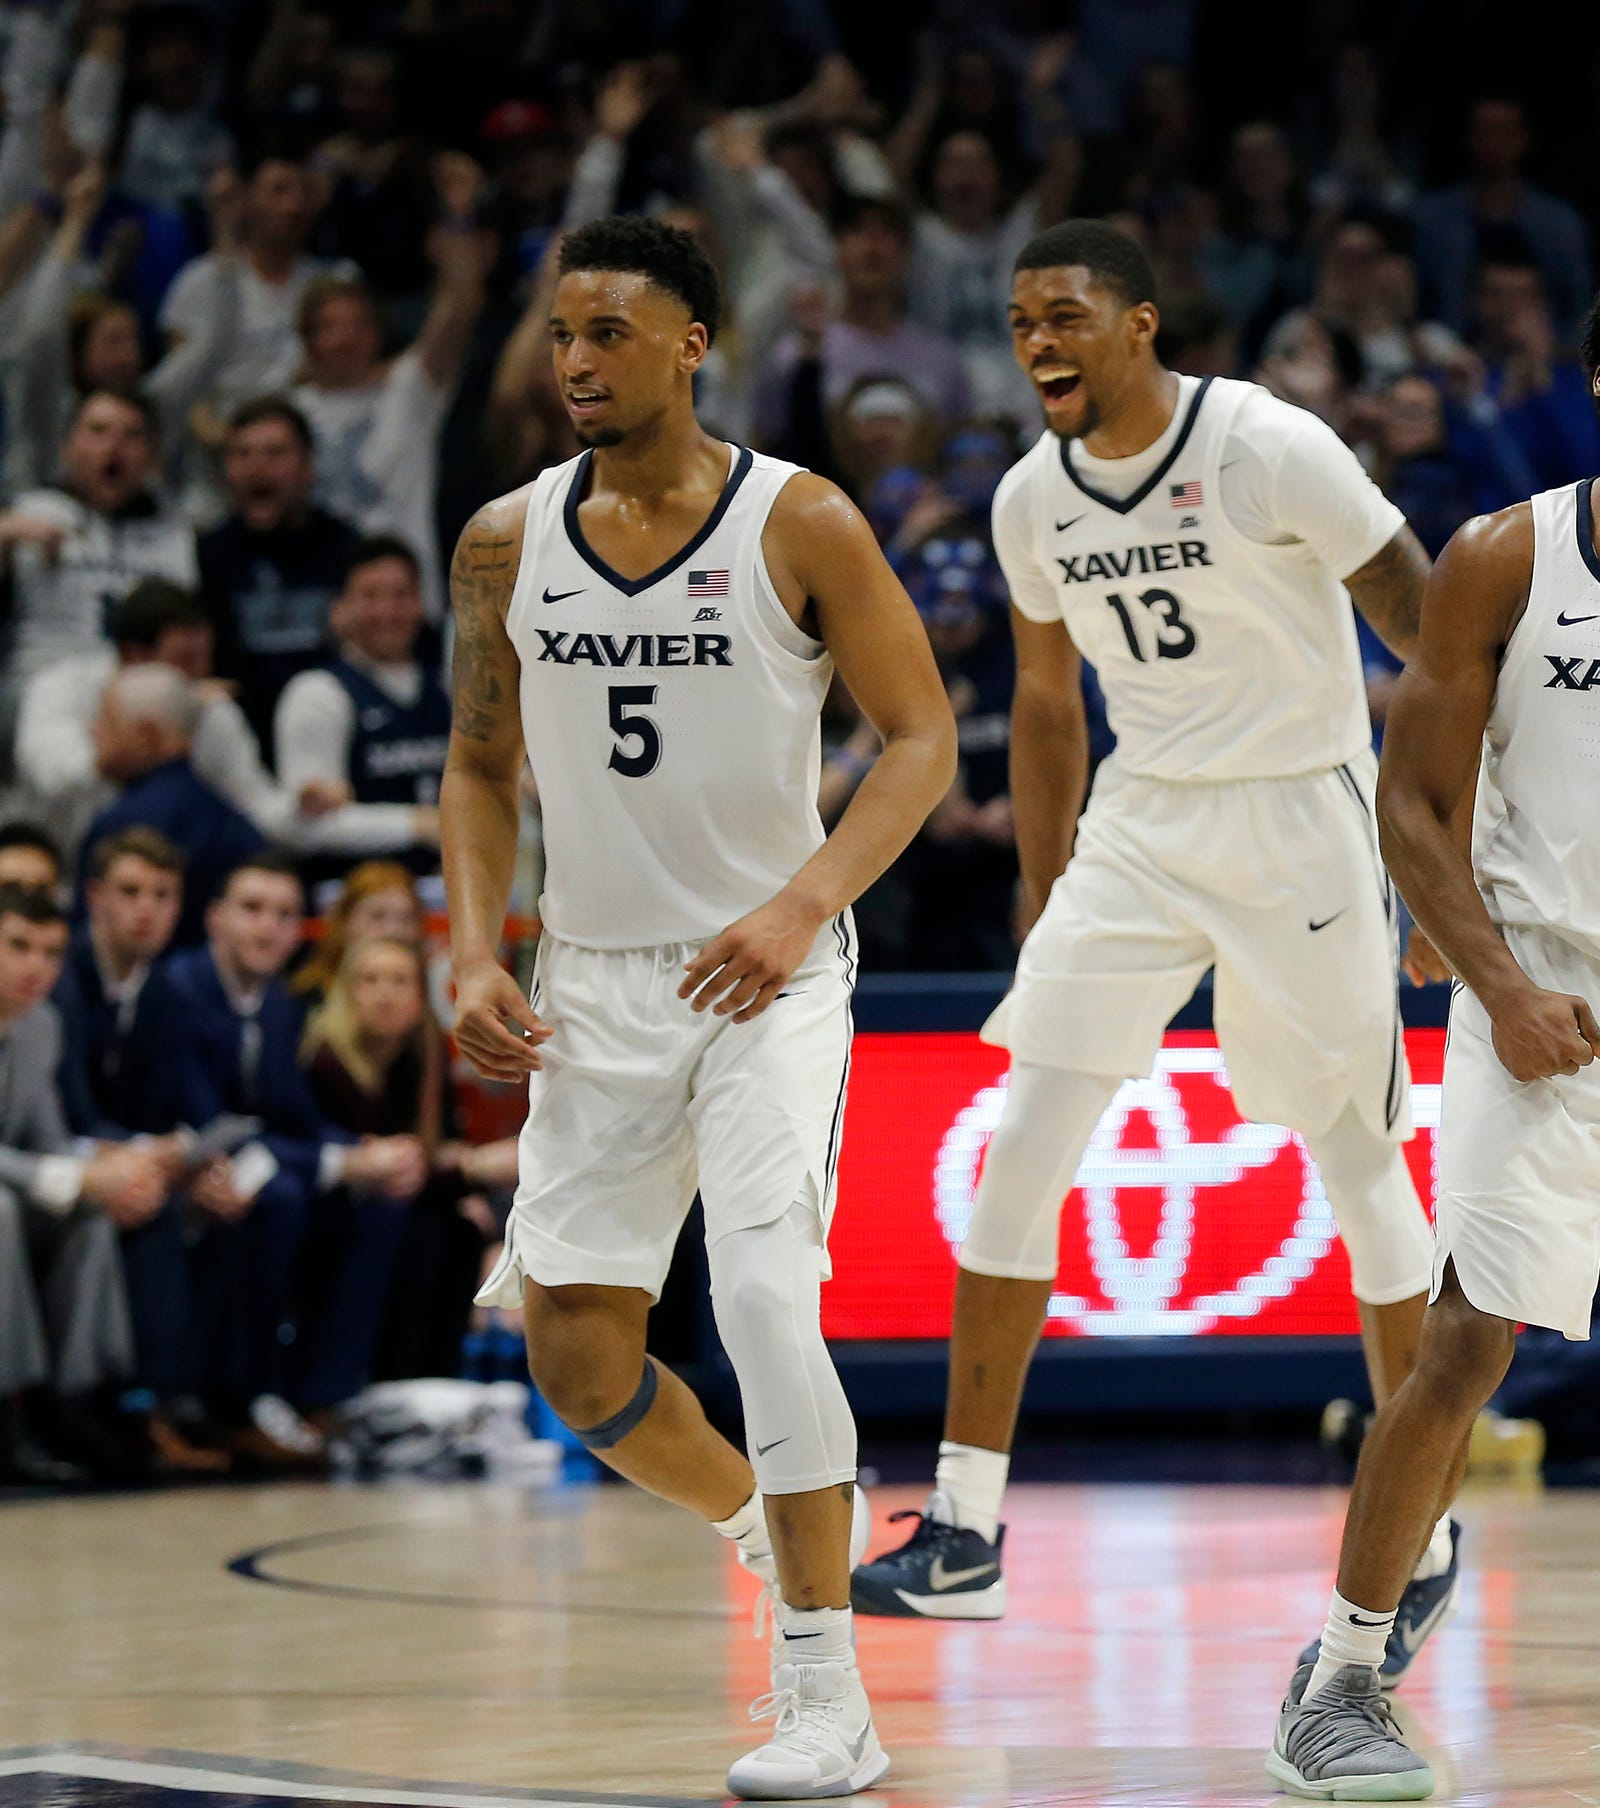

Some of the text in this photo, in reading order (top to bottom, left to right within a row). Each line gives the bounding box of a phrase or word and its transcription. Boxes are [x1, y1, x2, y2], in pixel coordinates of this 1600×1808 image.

[1056, 540, 1214, 584] XAVIER
[534, 629, 735, 667] XAVIER
[1105, 588, 1196, 663] 13
[607, 685, 663, 778] 5
